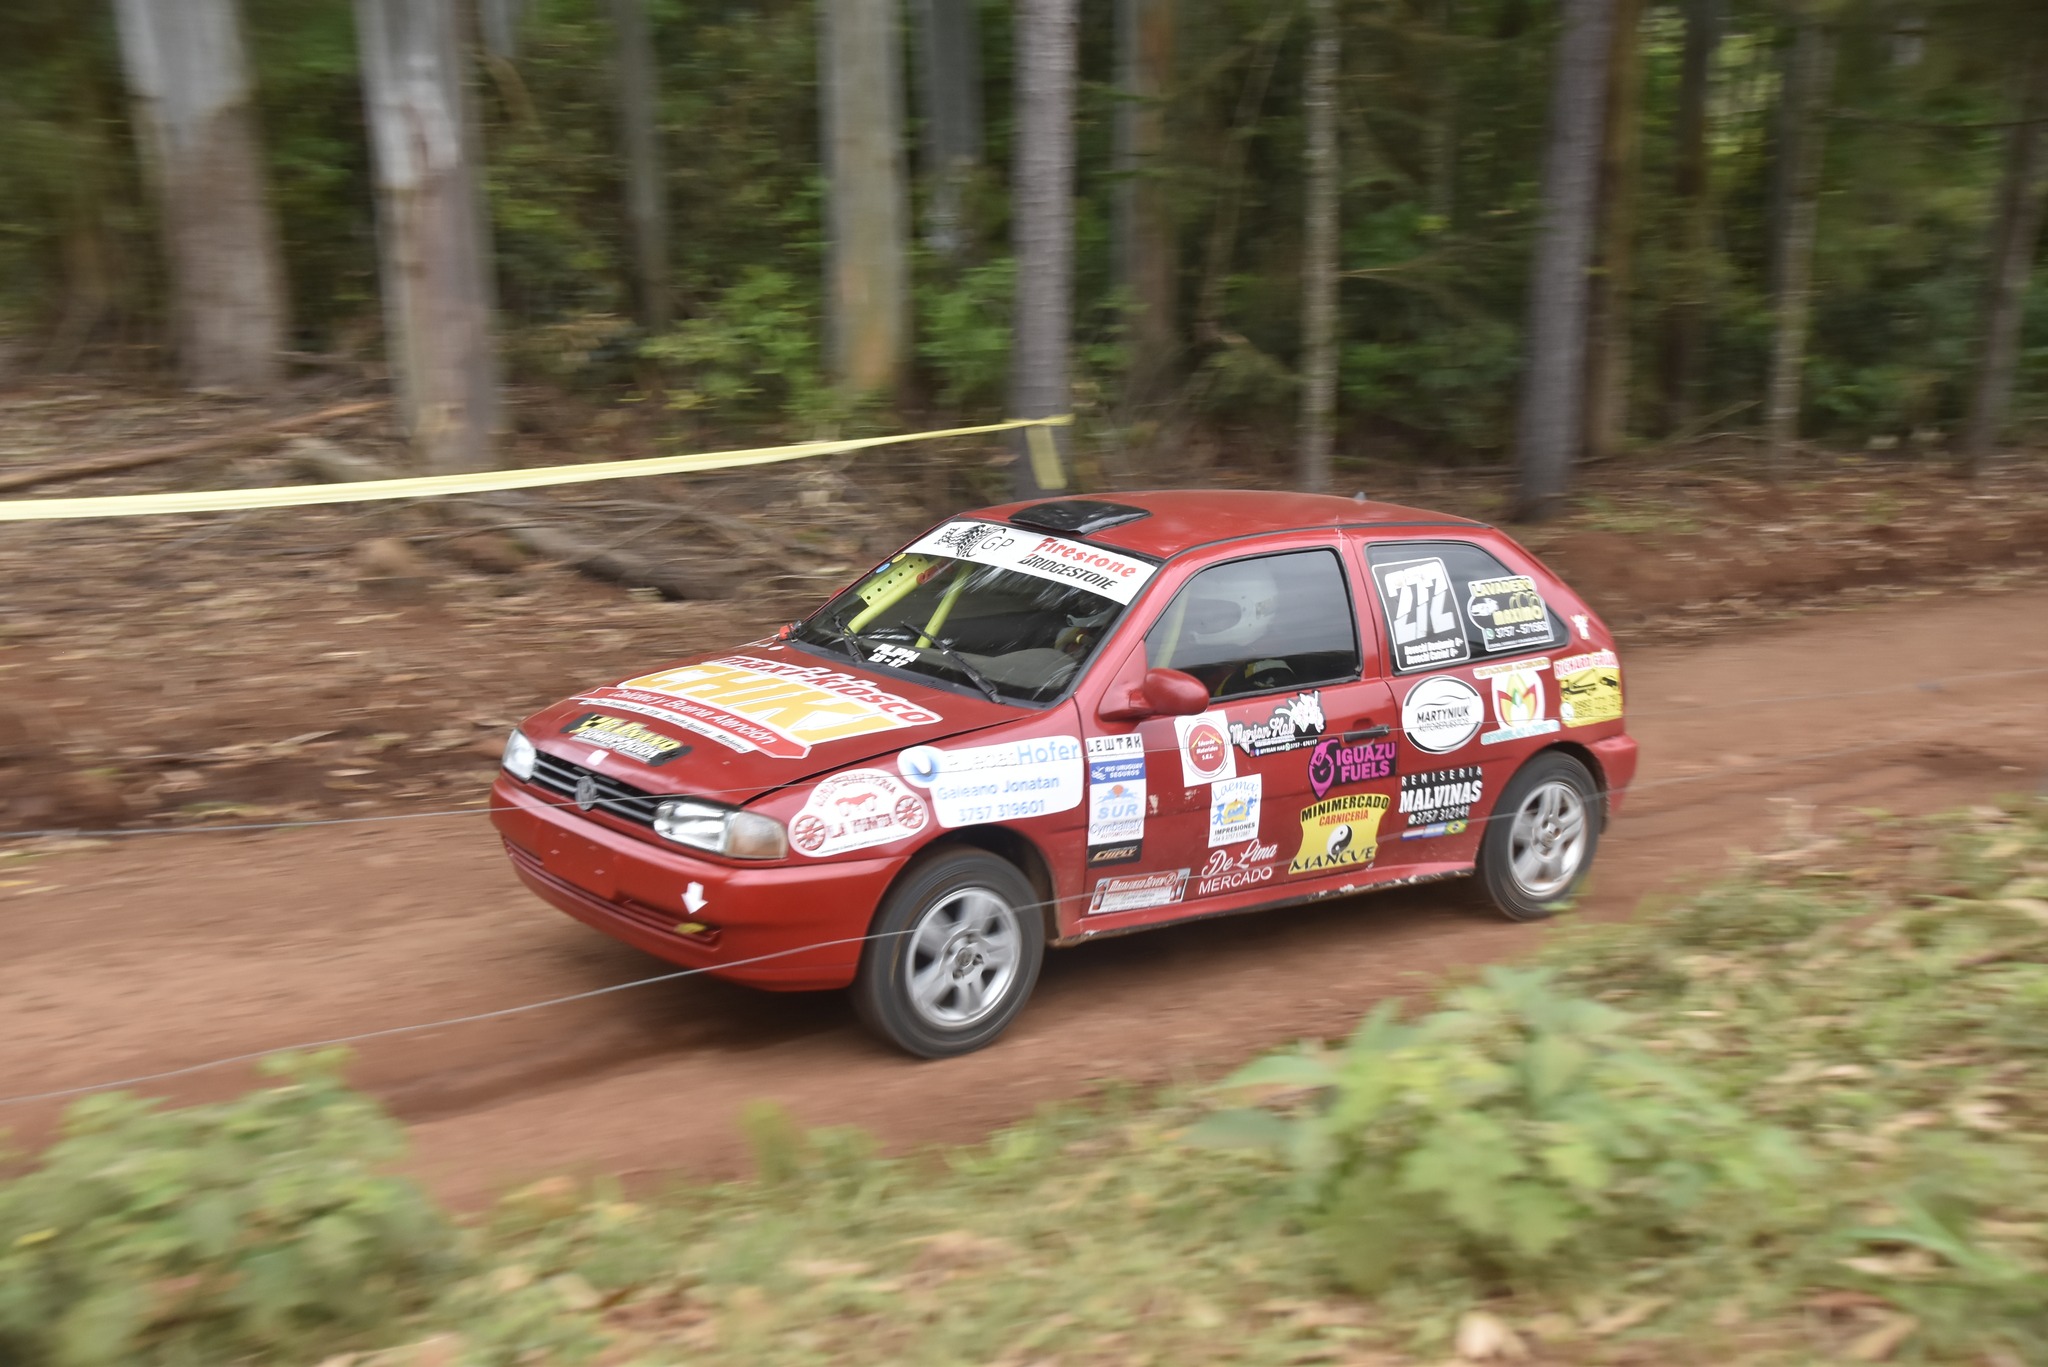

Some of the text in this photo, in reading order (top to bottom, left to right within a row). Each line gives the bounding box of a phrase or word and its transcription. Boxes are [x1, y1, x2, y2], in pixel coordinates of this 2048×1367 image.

[1033, 537, 1138, 579] Firestone
[1018, 554, 1118, 591] BRIDGESTONE
[1385, 562, 1456, 645] 272
[622, 664, 901, 743] CHIKI
[1416, 705, 1470, 724] MARTYNIUK
[1336, 742, 1396, 767] IGUAZU
[1341, 761, 1390, 783] FUELS
[1401, 765, 1482, 787] REMISERIA
[1002, 776, 1060, 794] Jonatan
[1399, 780, 1483, 813] MALVINAS
[959, 805, 992, 822] 3757
[1097, 804, 1138, 820] SUR
[1302, 795, 1389, 822] MINIMERCADO
[1319, 809, 1369, 827] CARNICERÍA
[1416, 810, 1438, 825] 3757
[1214, 822, 1255, 836] IMPRESIONES
[1201, 838, 1278, 878] De Lima
[1199, 866, 1273, 895] MERCADO
